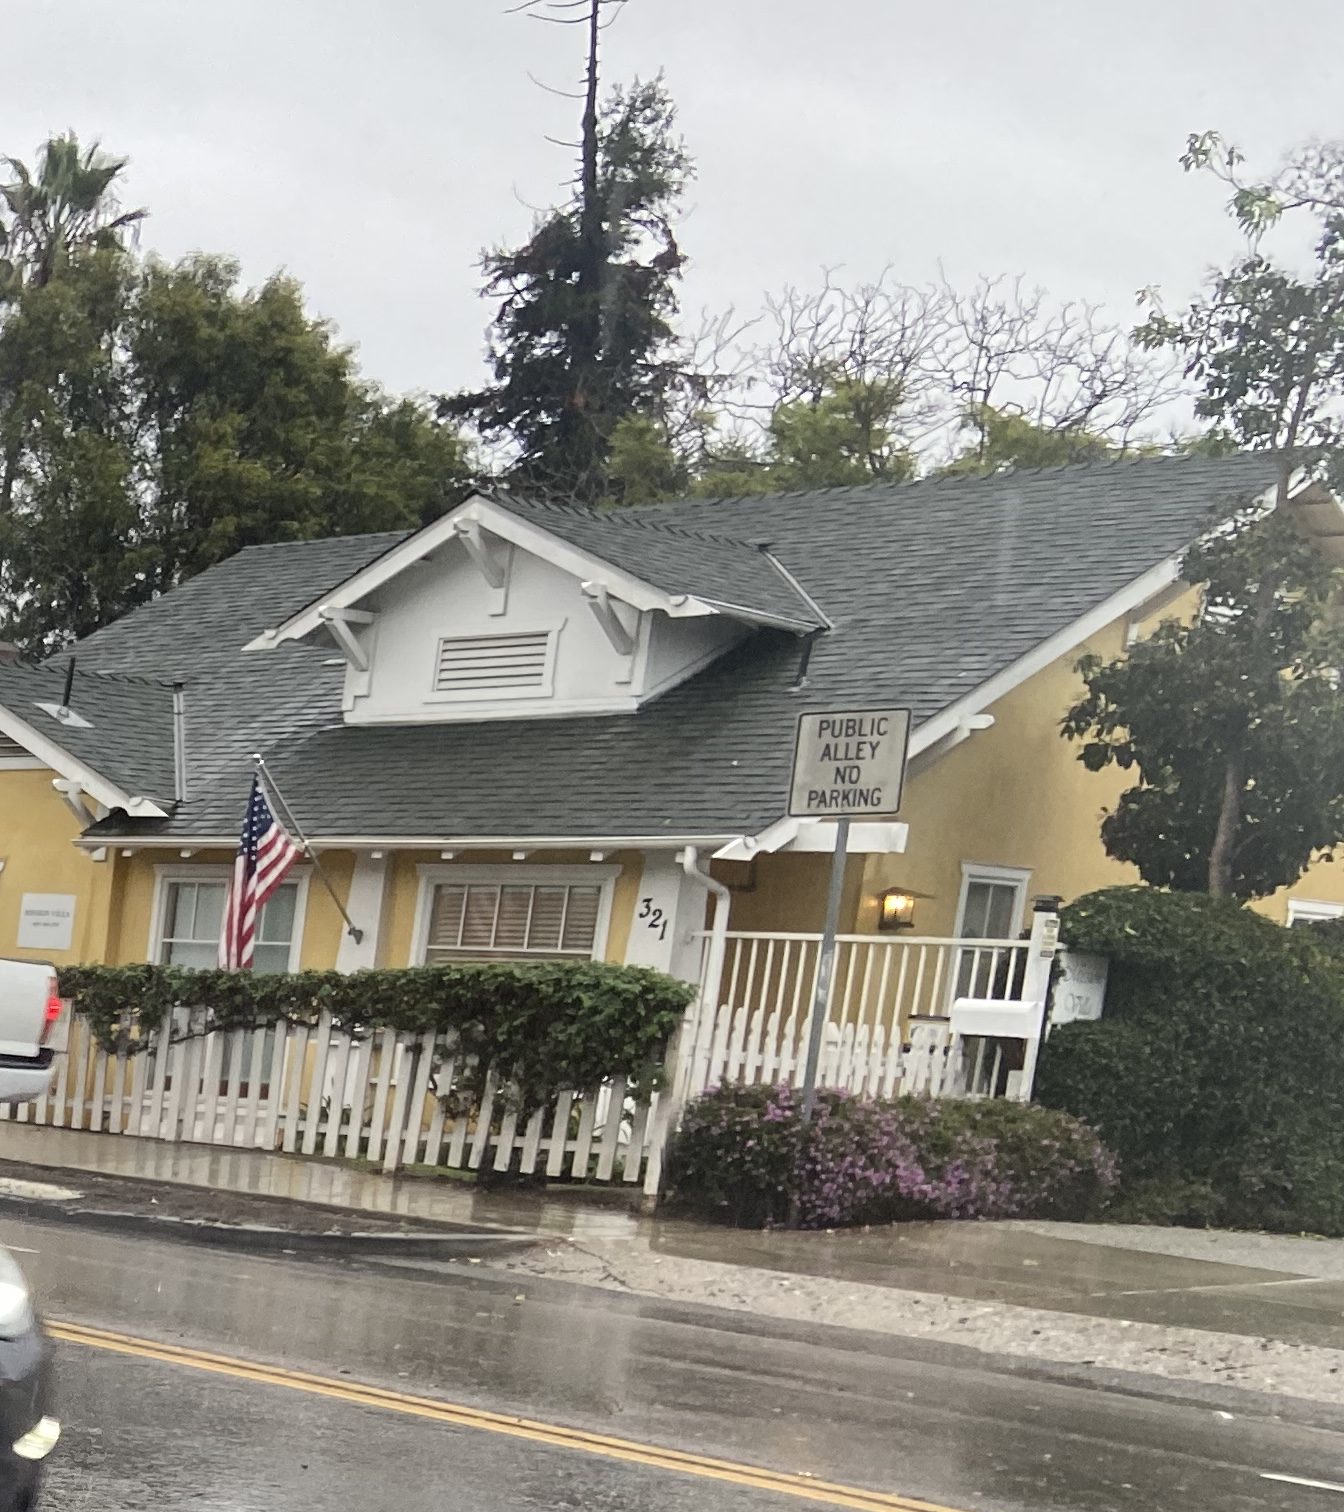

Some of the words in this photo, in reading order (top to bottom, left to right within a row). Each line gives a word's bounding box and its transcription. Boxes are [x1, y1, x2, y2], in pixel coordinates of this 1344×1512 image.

[818, 717, 889, 739] PUBLIC
[820, 741, 881, 762] ALLEY
[834, 765, 861, 785] NO
[807, 787, 882, 809] PARKING
[638, 897, 668, 941] 321
